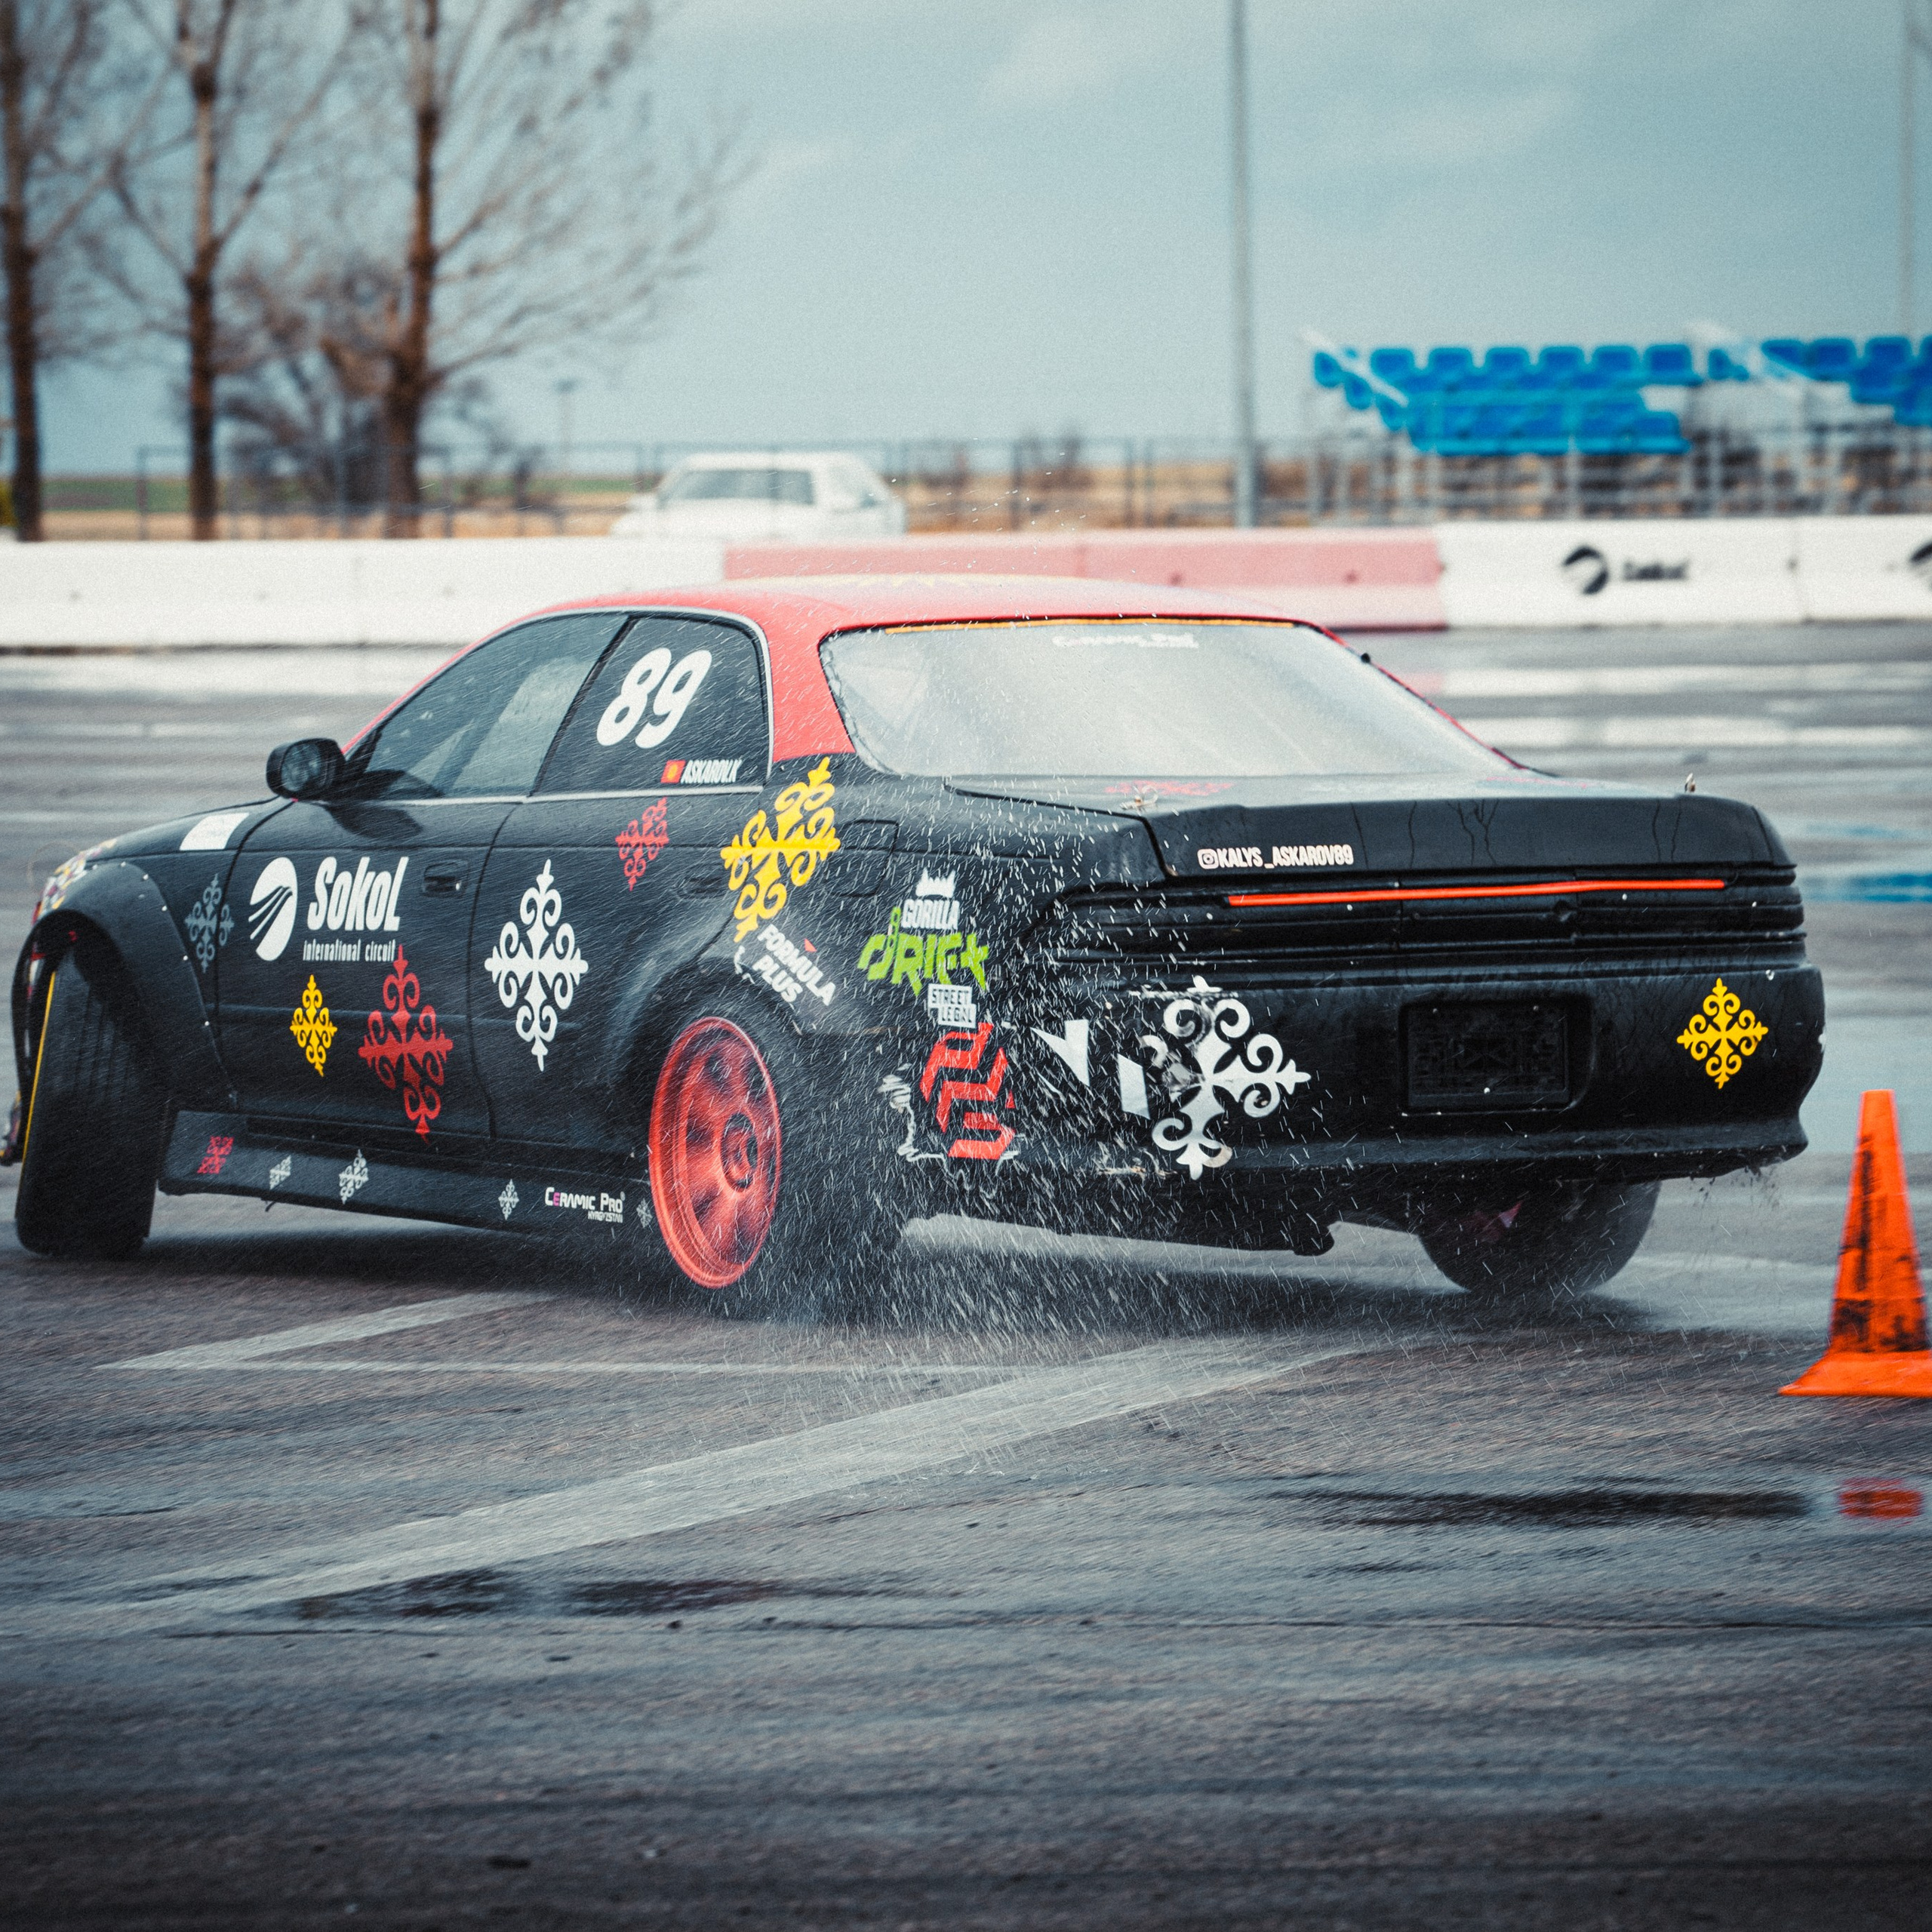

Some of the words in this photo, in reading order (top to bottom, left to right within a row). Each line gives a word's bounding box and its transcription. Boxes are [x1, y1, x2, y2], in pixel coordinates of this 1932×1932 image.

[596, 648, 712, 749] 89
[901, 899, 960, 930] GORILLA
[752, 954, 803, 1002] PLUS
[757, 923, 835, 1006] FORMULA
[932, 989, 970, 1005] STREET
[942, 1006, 972, 1023] LEGAL
